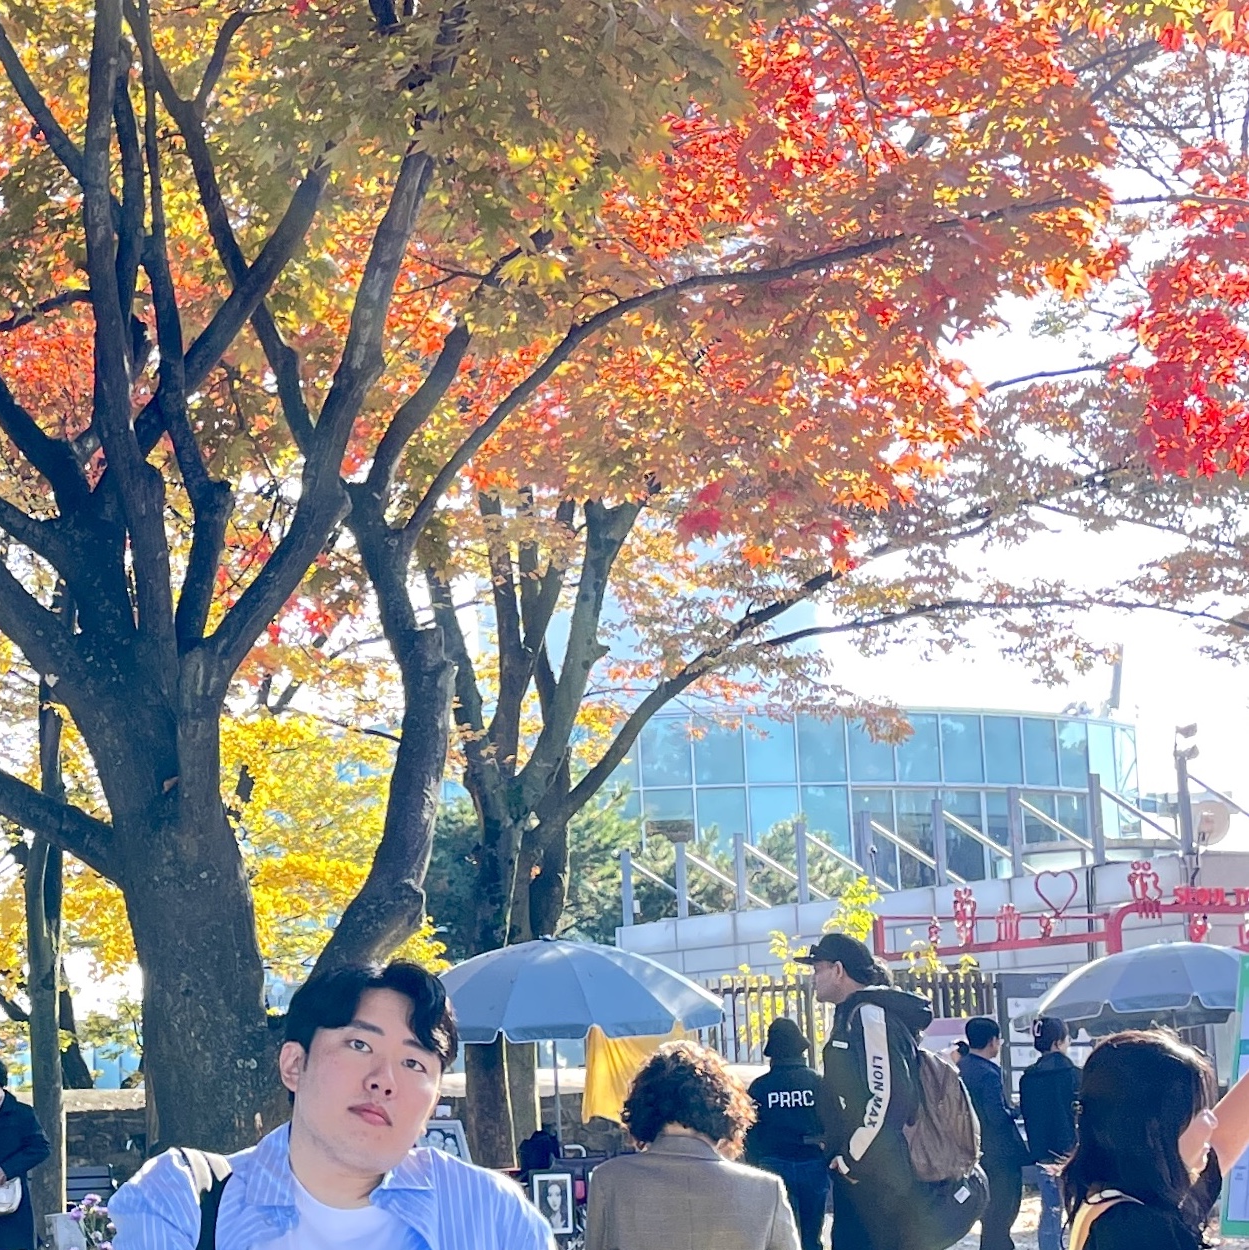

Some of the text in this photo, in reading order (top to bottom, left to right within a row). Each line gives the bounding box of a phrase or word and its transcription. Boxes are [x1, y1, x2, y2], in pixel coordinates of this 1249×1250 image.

[1173, 886, 1231, 905] SEOUL
[767, 1089, 815, 1109] PRRC
[866, 1055, 884, 1128] LION MAX
